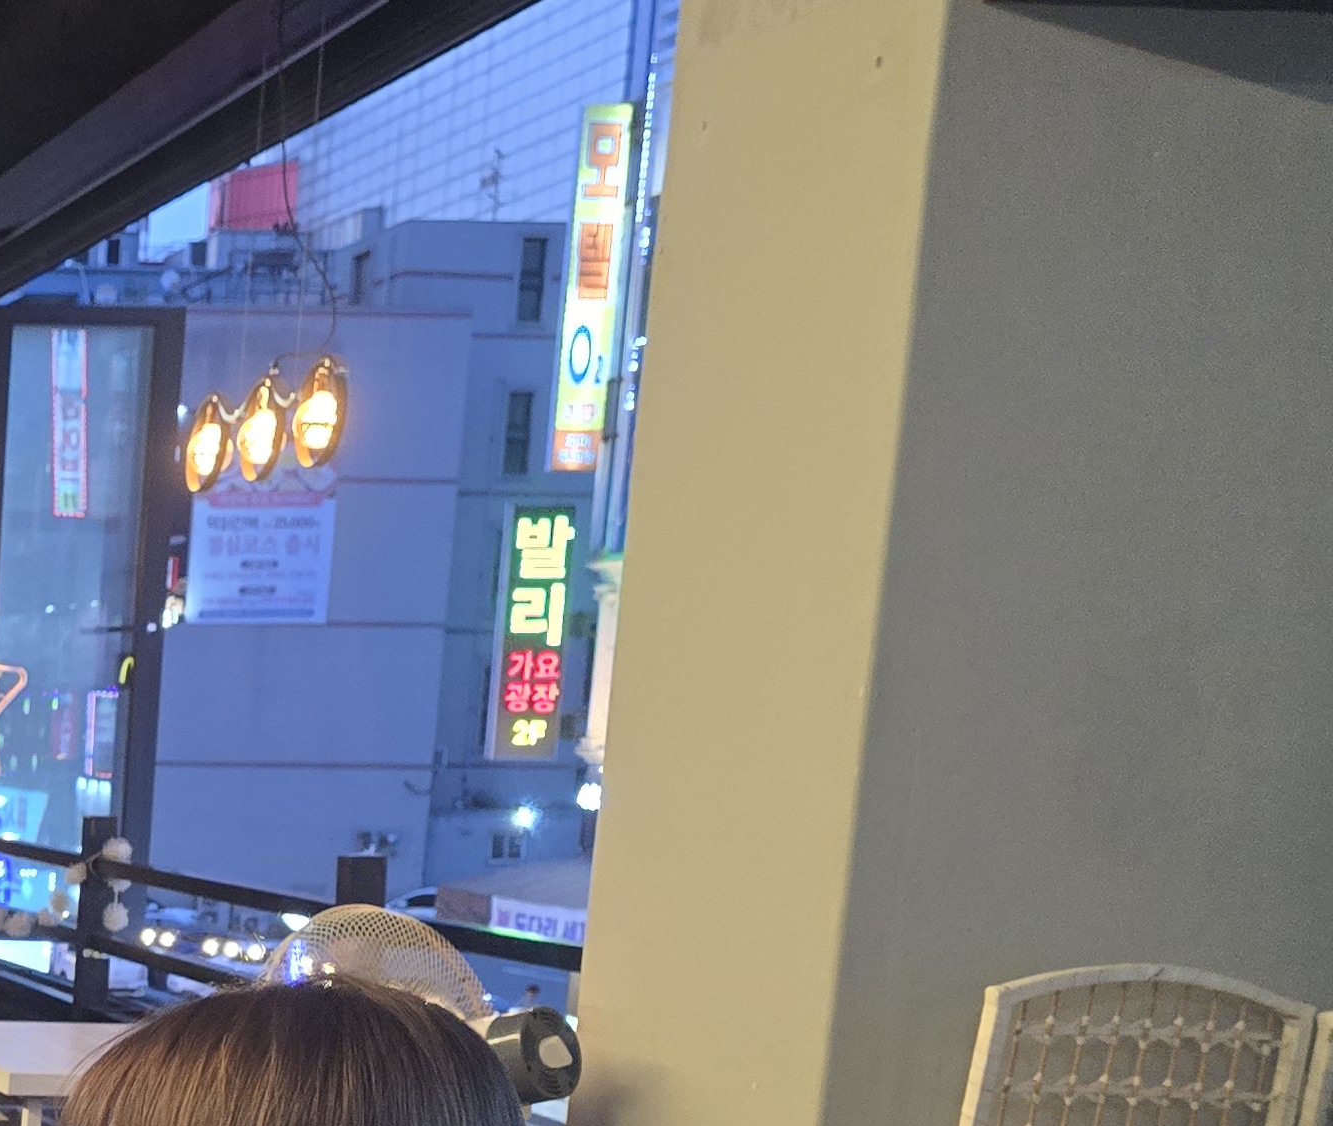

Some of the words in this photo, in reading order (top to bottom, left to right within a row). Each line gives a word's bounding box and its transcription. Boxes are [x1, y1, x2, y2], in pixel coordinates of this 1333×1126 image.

[577, 121, 623, 301] 모텔
[509, 514, 576, 647] 발리
[507, 650, 560, 681] 가요
[504, 681, 560, 714] 광장
[511, 718, 548, 746] 2F
